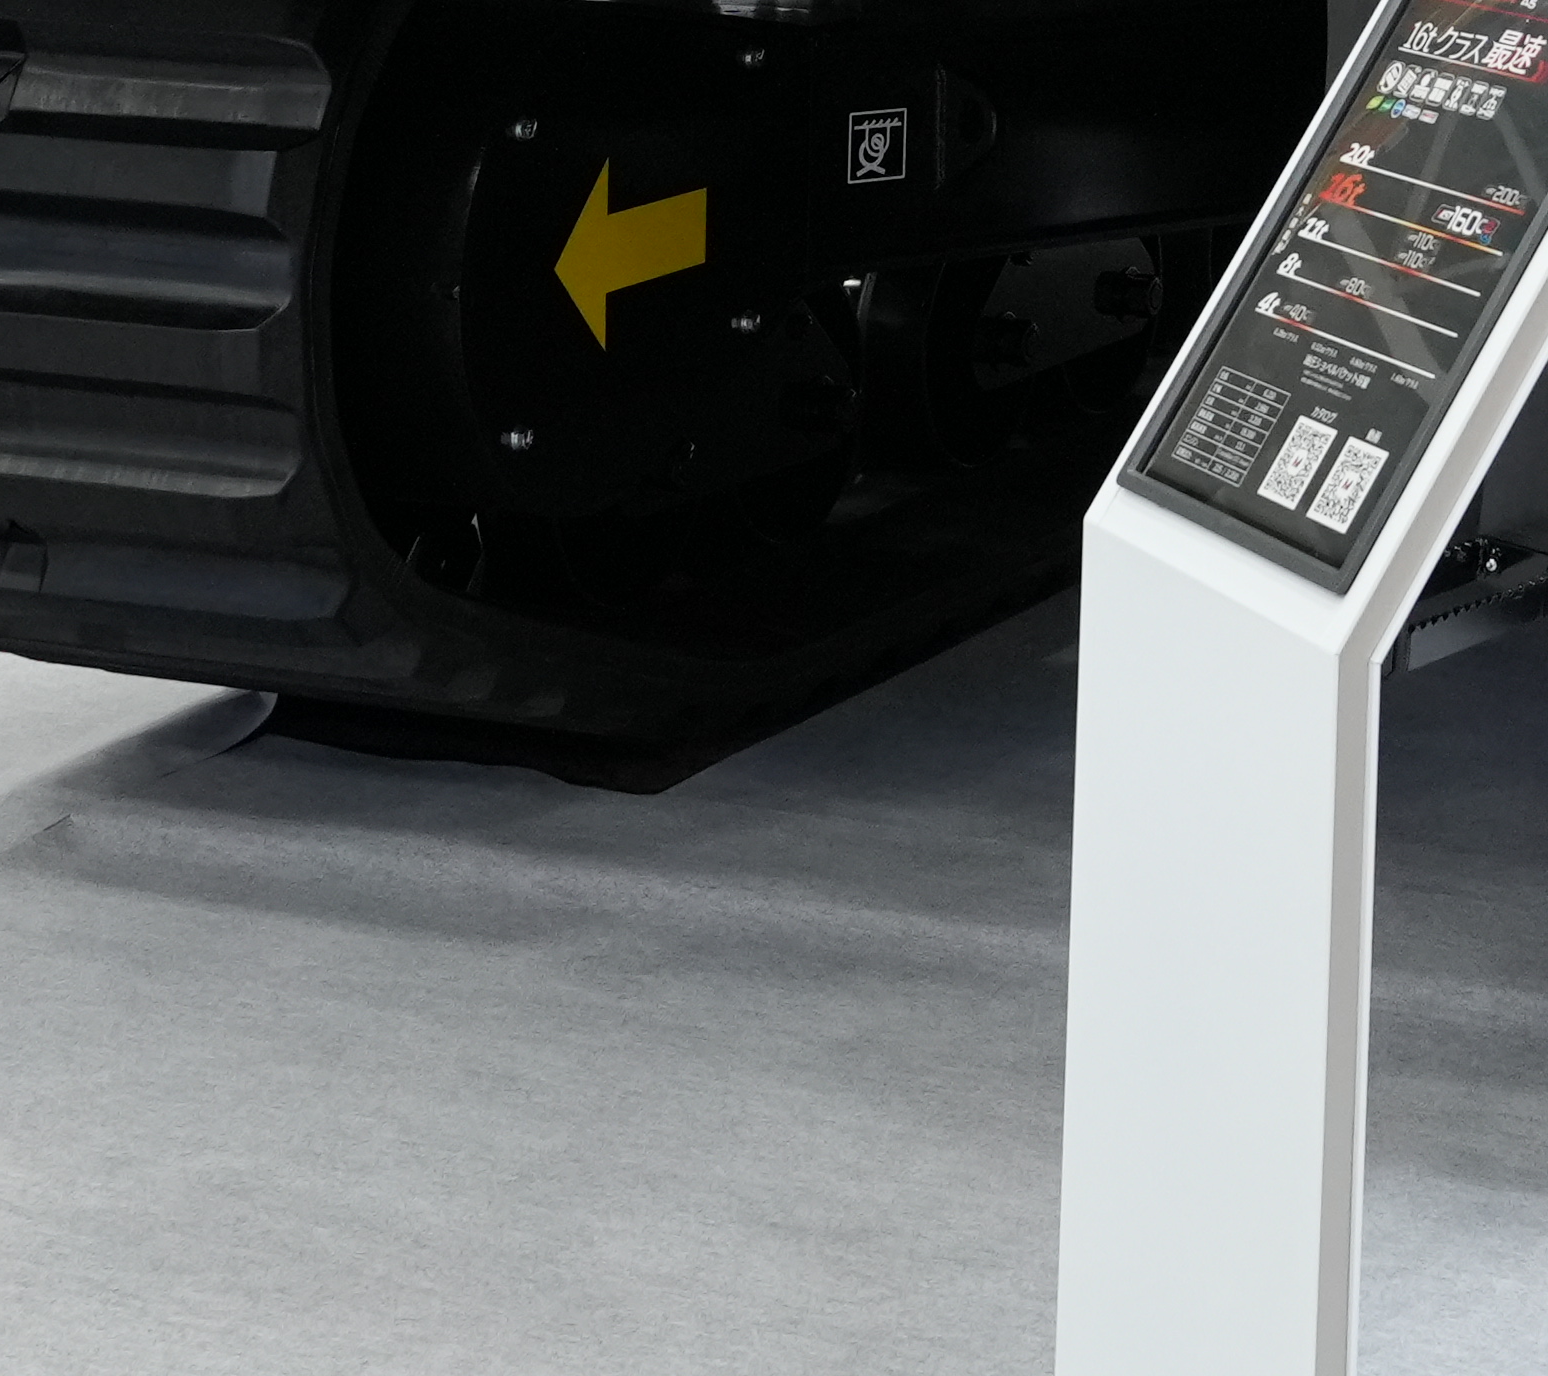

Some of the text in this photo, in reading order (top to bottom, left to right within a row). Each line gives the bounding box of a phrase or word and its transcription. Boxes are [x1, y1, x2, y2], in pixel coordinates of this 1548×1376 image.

[1340, 142, 1375, 166] 20t
[1319, 172, 1366, 207] 16t
[1277, 253, 1302, 276] 8t
[1256, 292, 1280, 314] 4t
